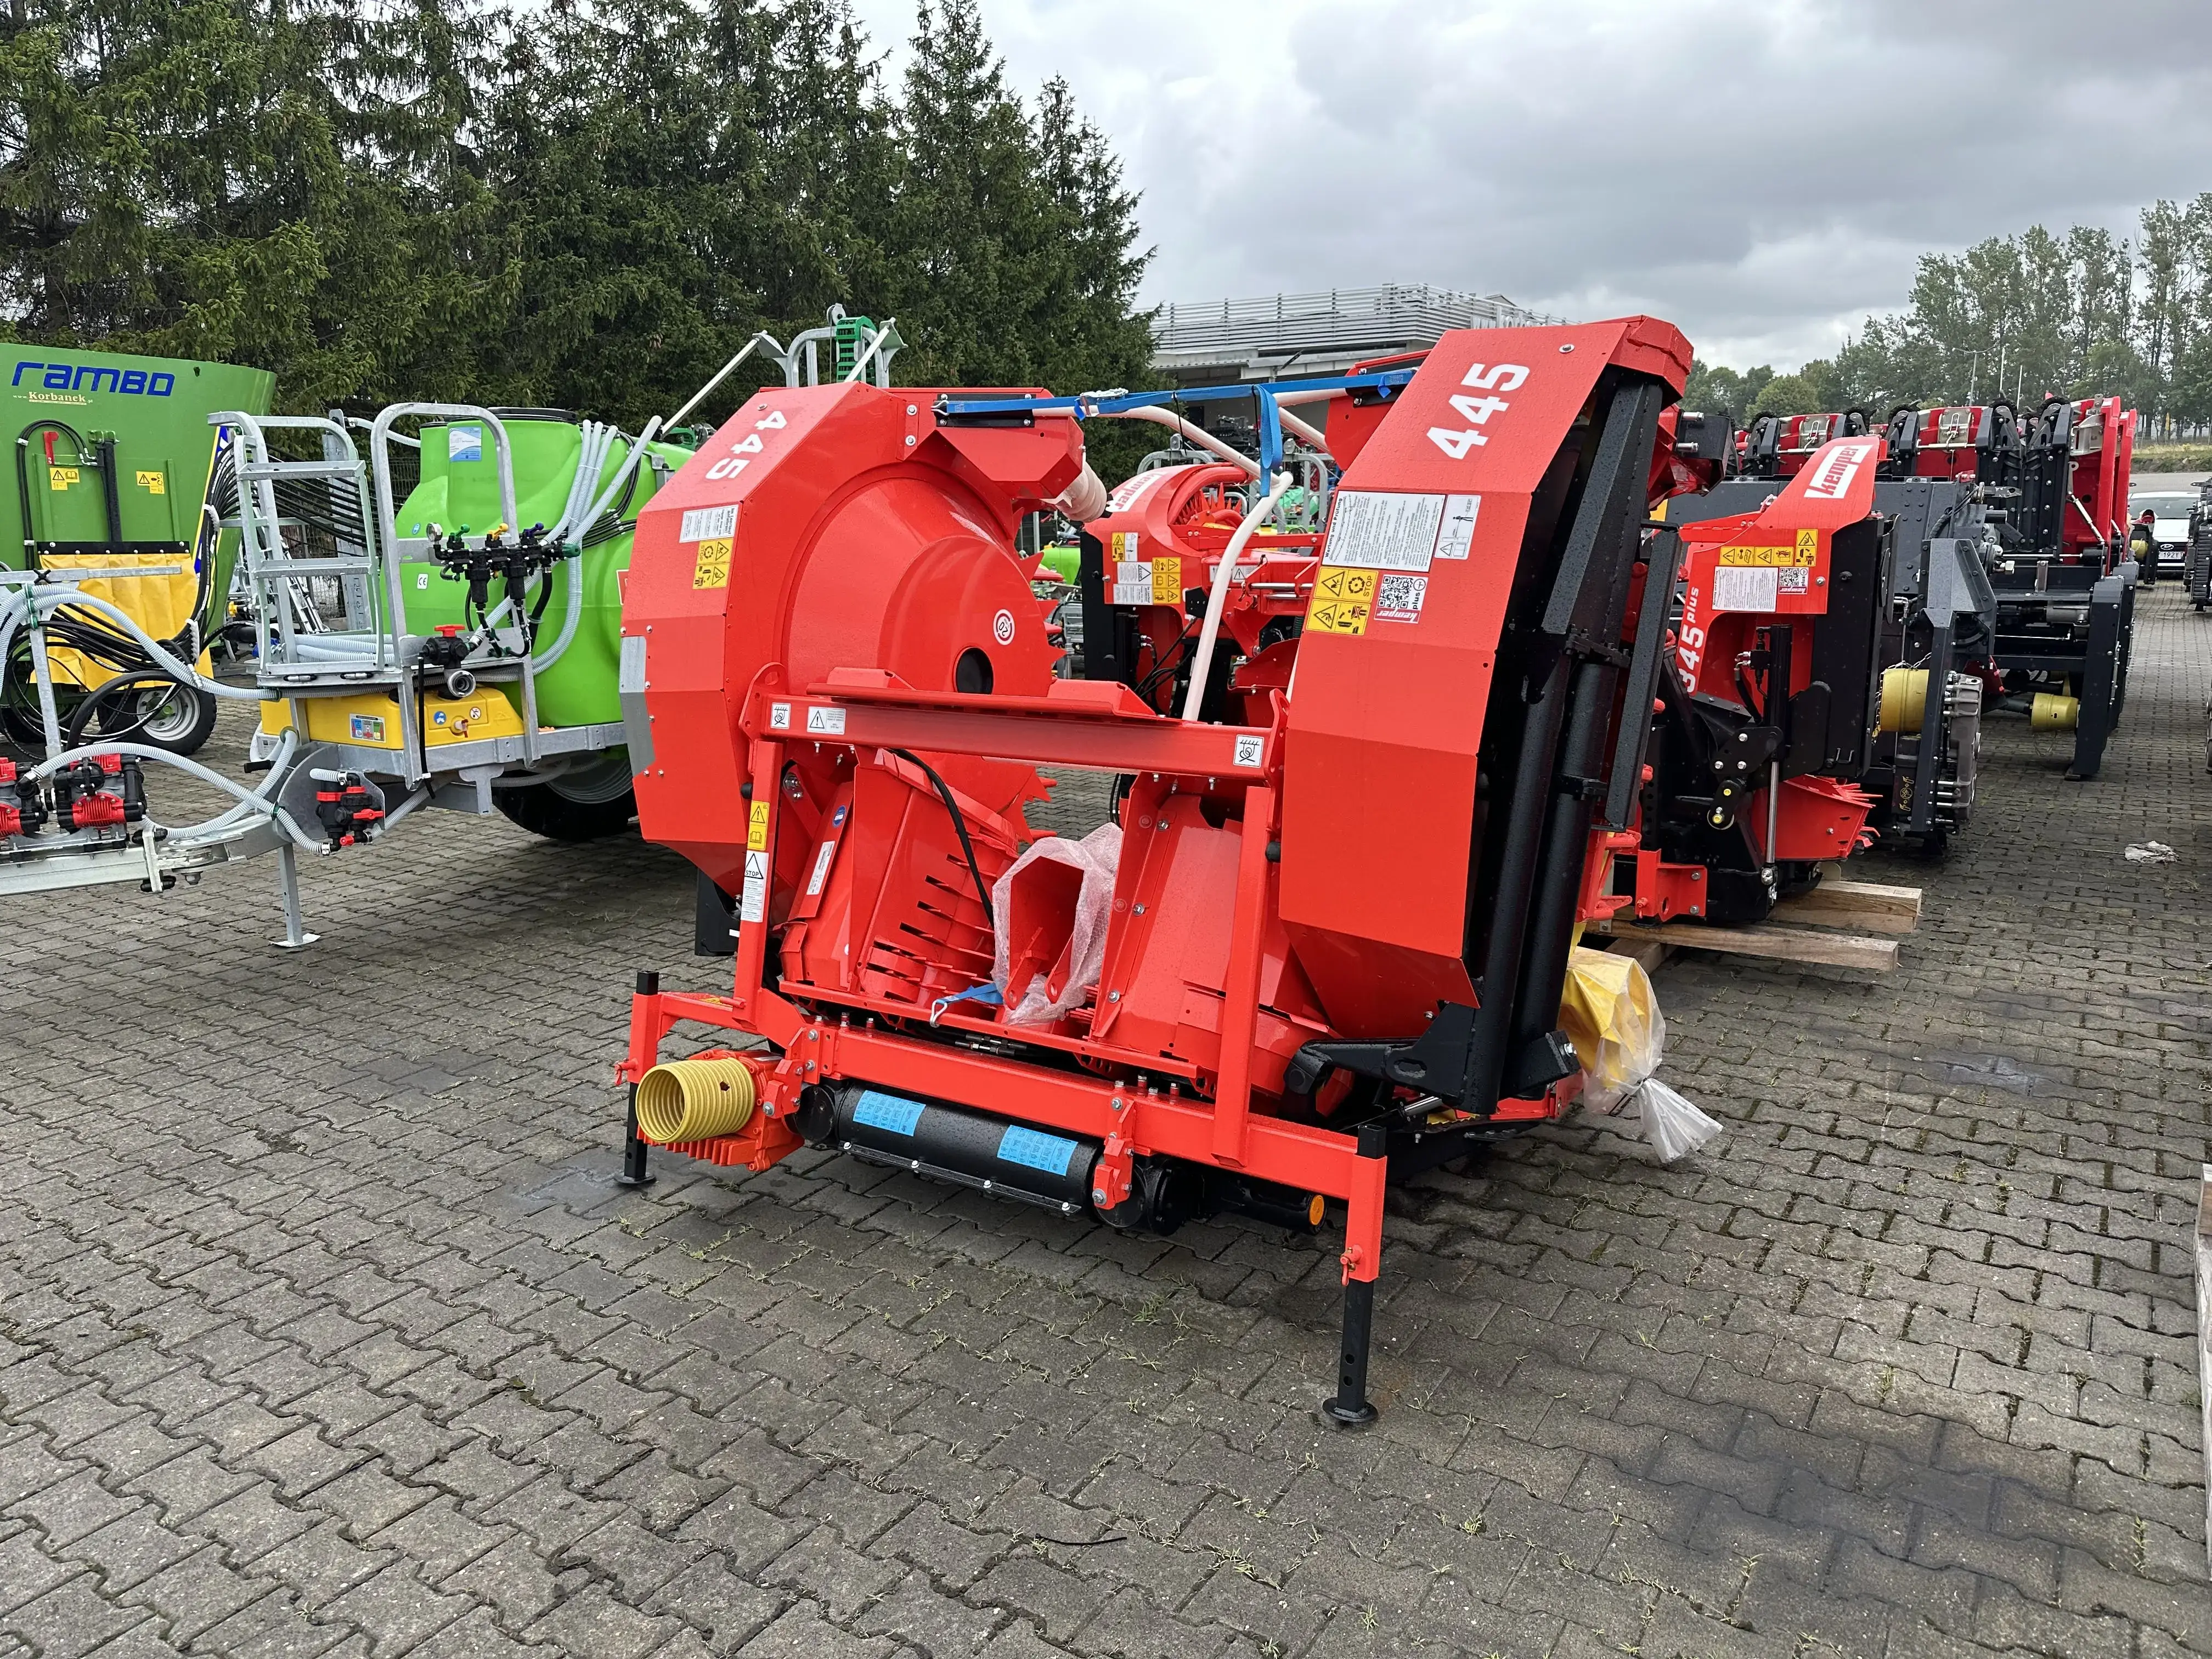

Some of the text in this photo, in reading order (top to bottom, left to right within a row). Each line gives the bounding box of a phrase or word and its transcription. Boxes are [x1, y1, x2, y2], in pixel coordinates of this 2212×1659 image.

[1426, 363, 1530, 460] 445
[706, 410, 788, 480] 445
[1809, 446, 1860, 496] kemper
[1325, 534, 1334, 557] Wartung
[1334, 498, 1342, 521] Prüfung
[419, 577, 426, 585] CE
[1363, 575, 1373, 597] STOP
[1412, 592, 1420, 610] plus
[999, 622, 1008, 636] 20
[1679, 586, 1704, 693] 345 plus
